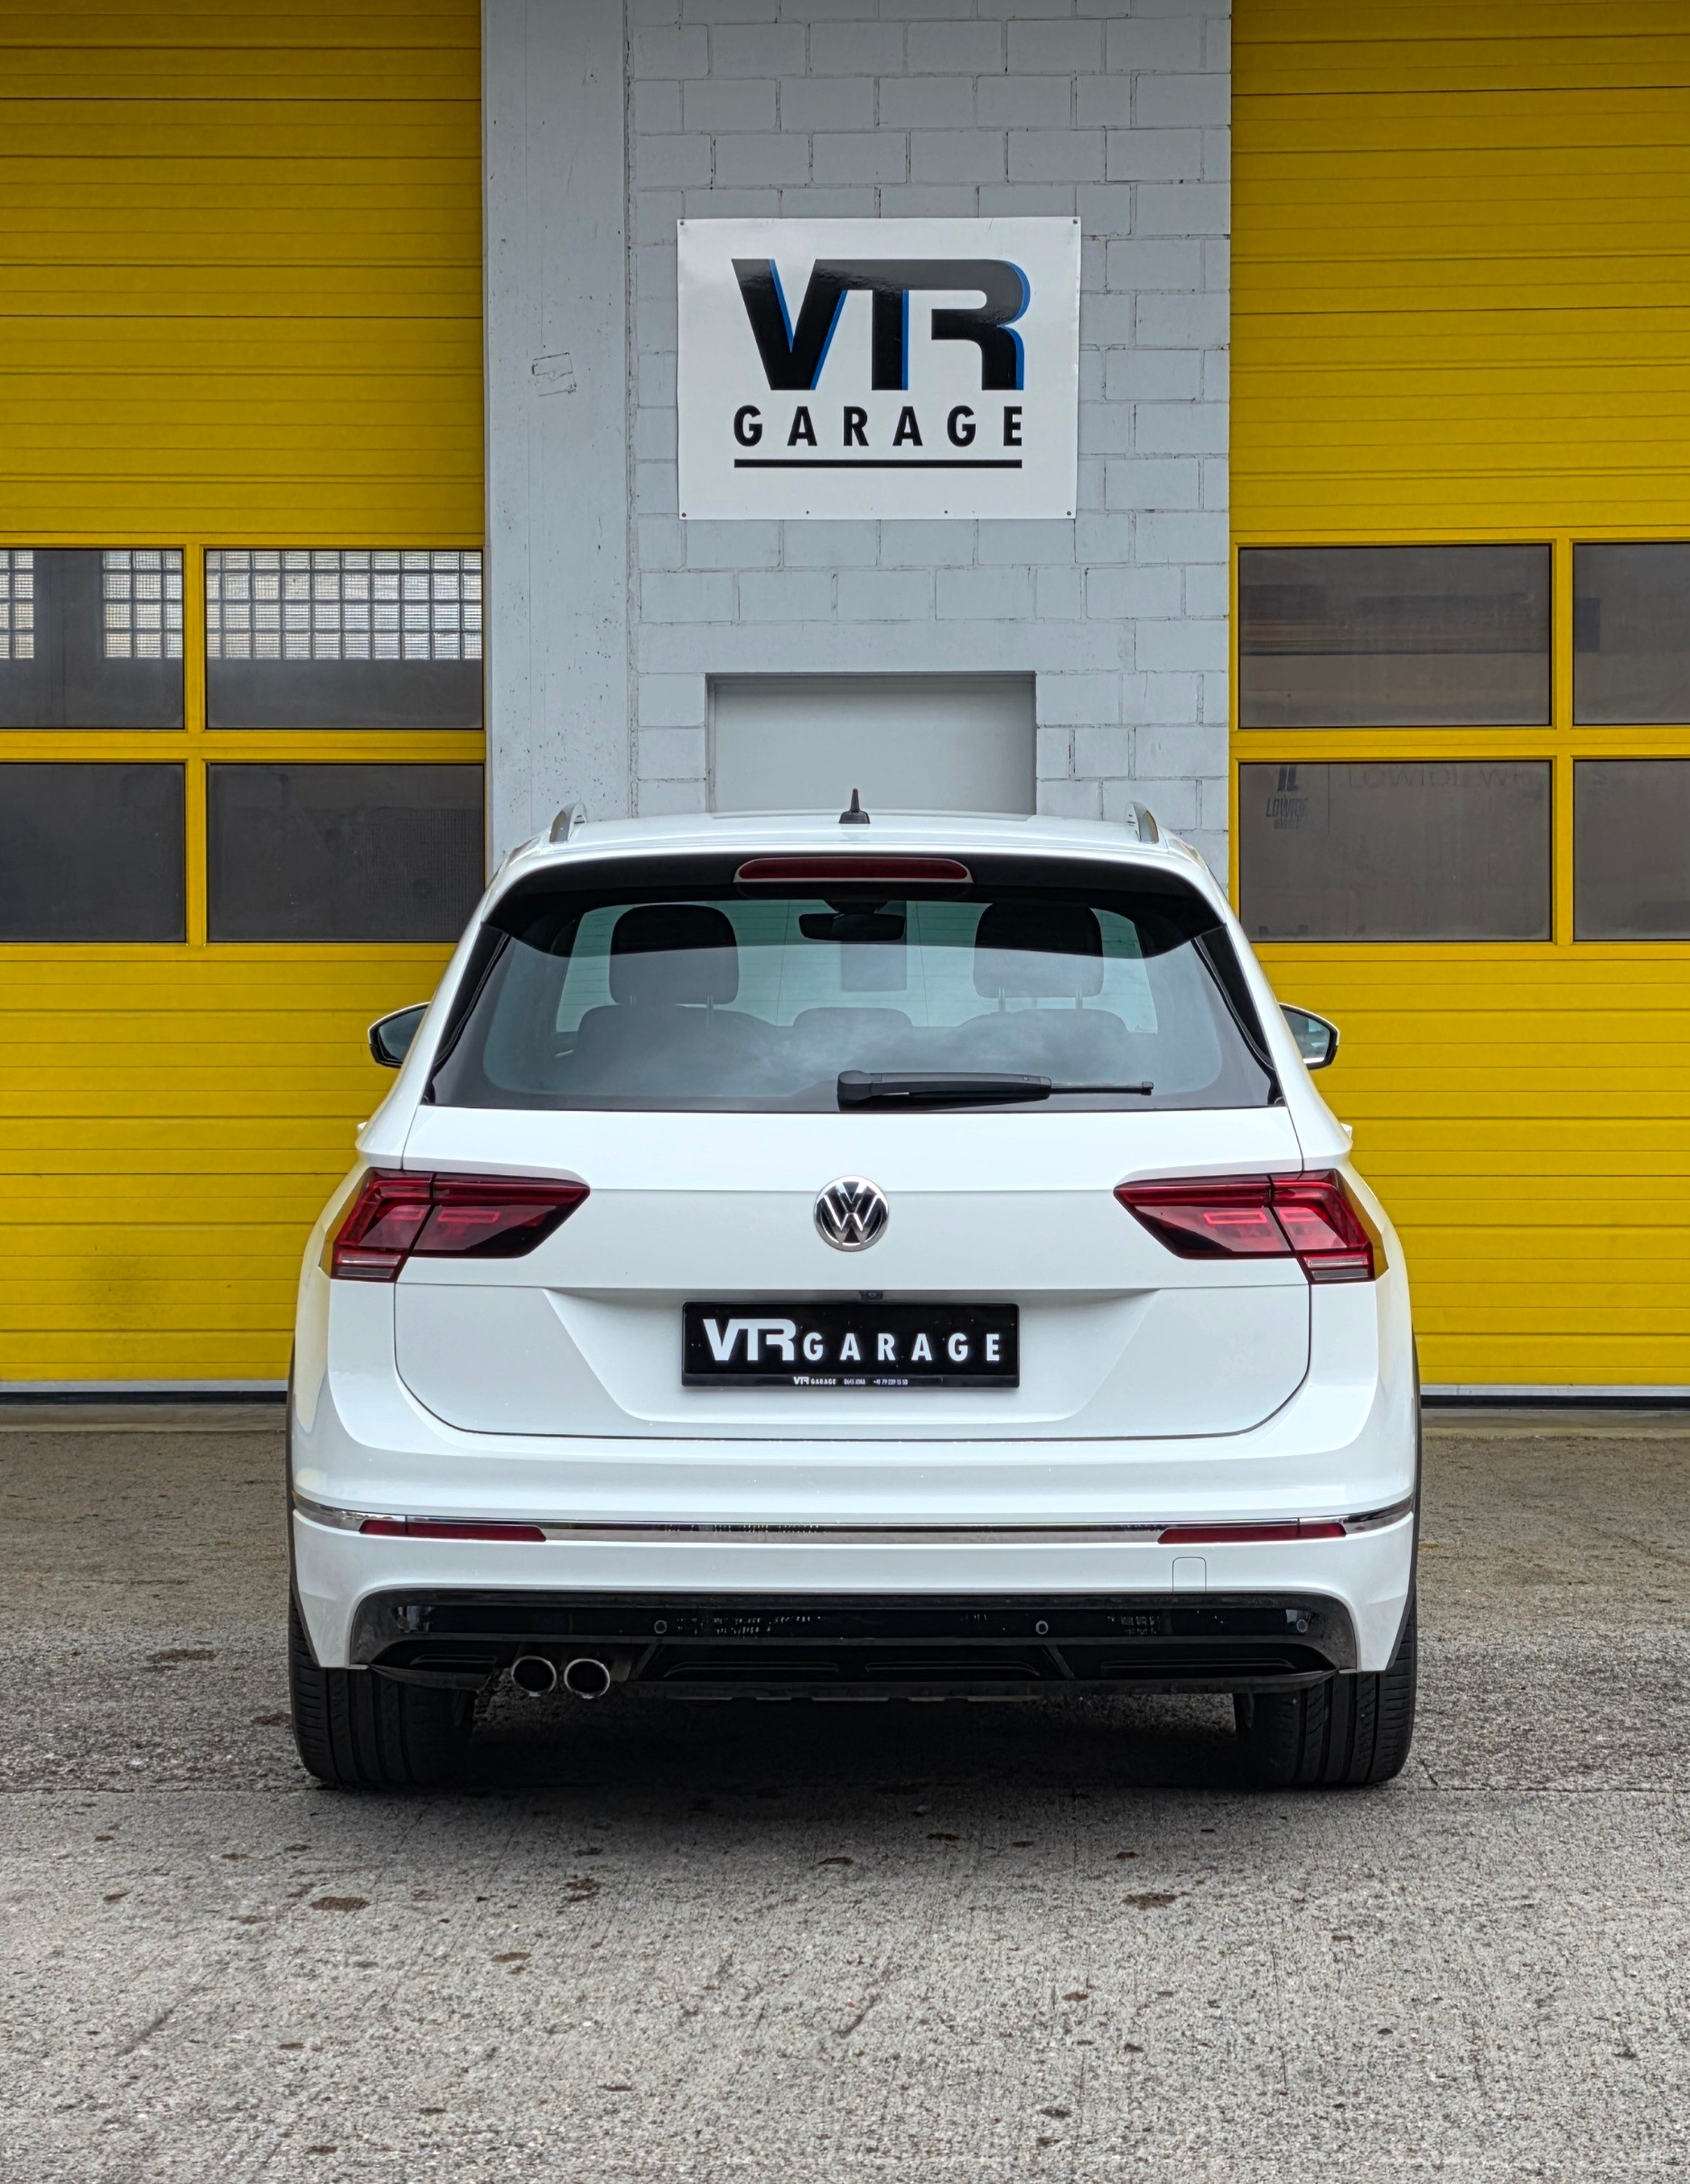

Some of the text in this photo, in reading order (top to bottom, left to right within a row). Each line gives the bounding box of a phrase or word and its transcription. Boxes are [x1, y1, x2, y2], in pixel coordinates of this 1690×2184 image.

[731, 258, 1031, 390] VTR
[733, 405, 1022, 447] GARAGE
[703, 1319, 1000, 1362] VTR GARAGE
[793, 1376, 810, 1386] VTR
